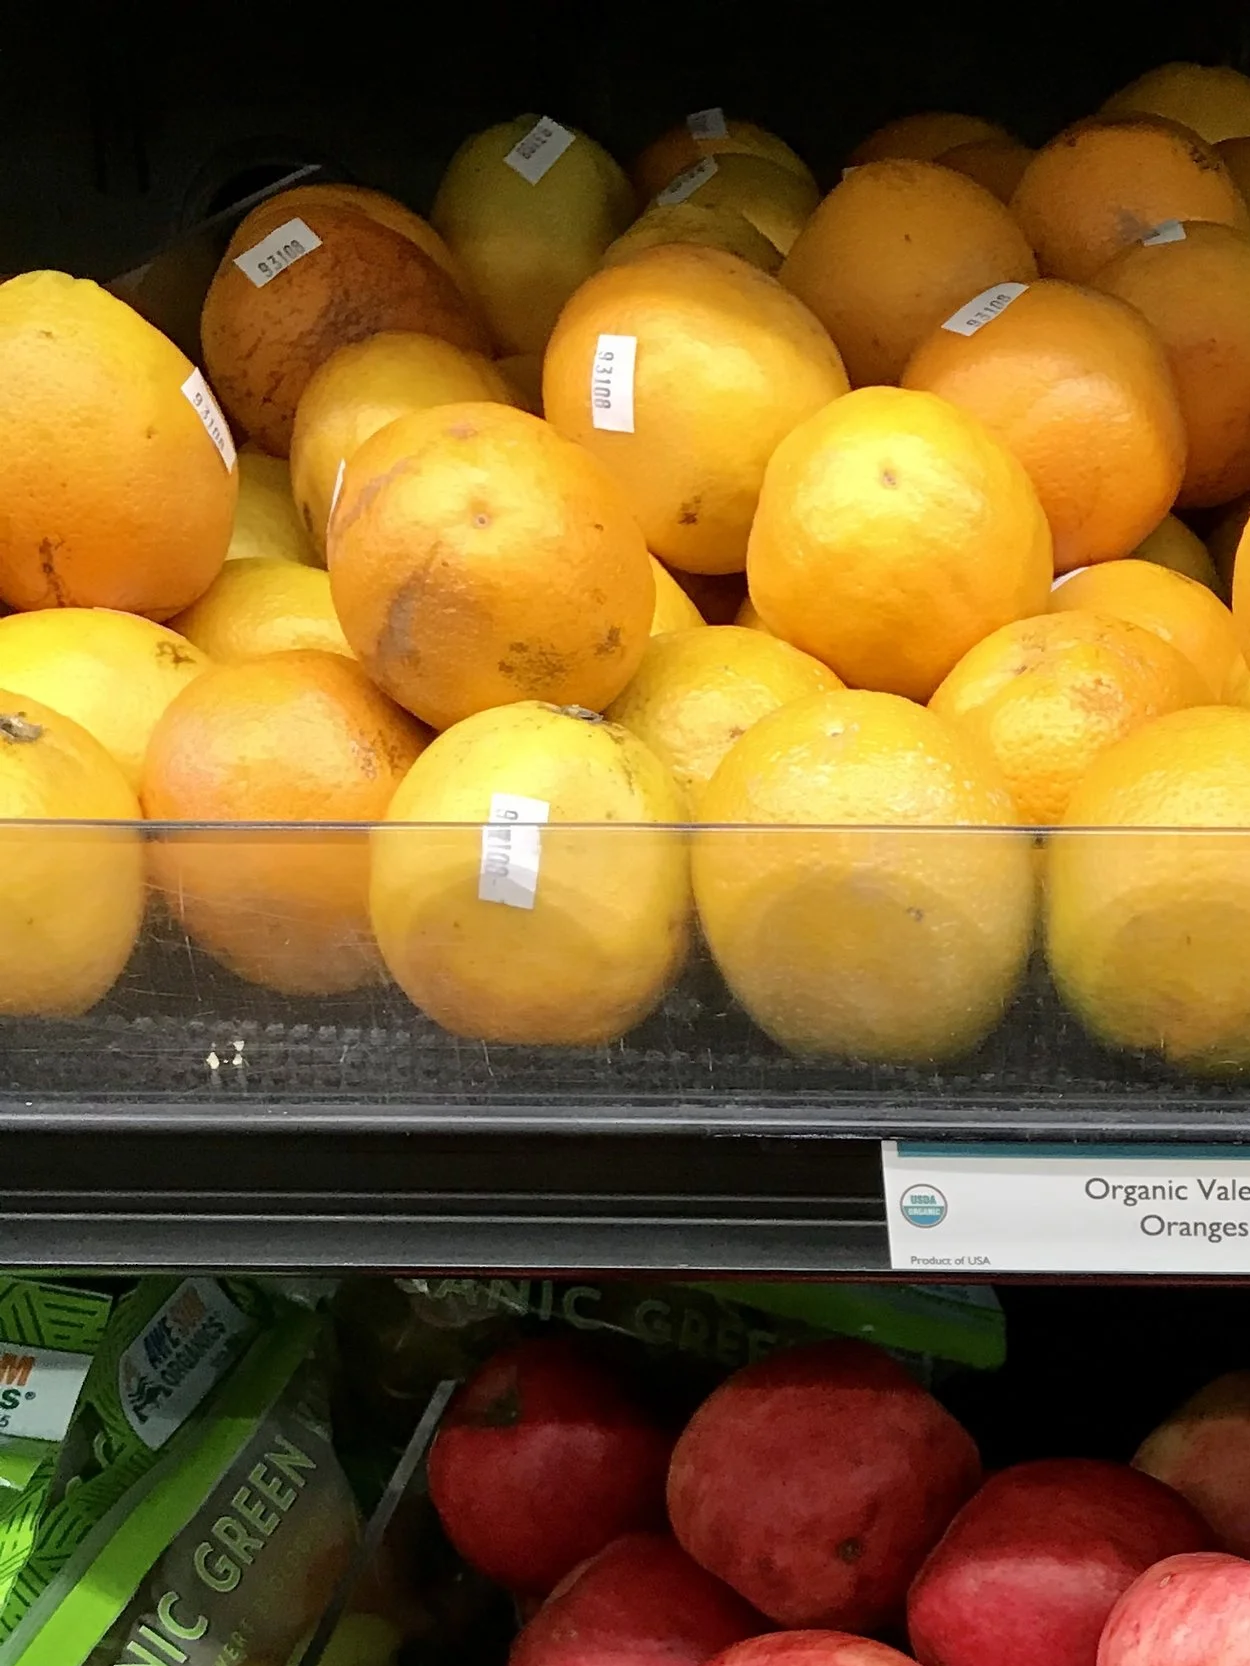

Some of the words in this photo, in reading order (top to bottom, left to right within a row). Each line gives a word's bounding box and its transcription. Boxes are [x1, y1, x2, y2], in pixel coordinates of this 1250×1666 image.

[257, 239, 306, 278] 93108
[964, 293, 1012, 328] 93108
[593, 351, 615, 410] 93108
[910, 1195, 937, 1205] USDA
[1085, 1177, 1188, 1207] Organic
[908, 1207, 941, 1216] ORGANIC
[1140, 1214, 1249, 1243] Oranges
[911, 1256, 951, 1266] Product
[954, 1256, 965, 1266] of
[967, 1257, 991, 1266] USA
[194, 1434, 316, 1593] GREEN
